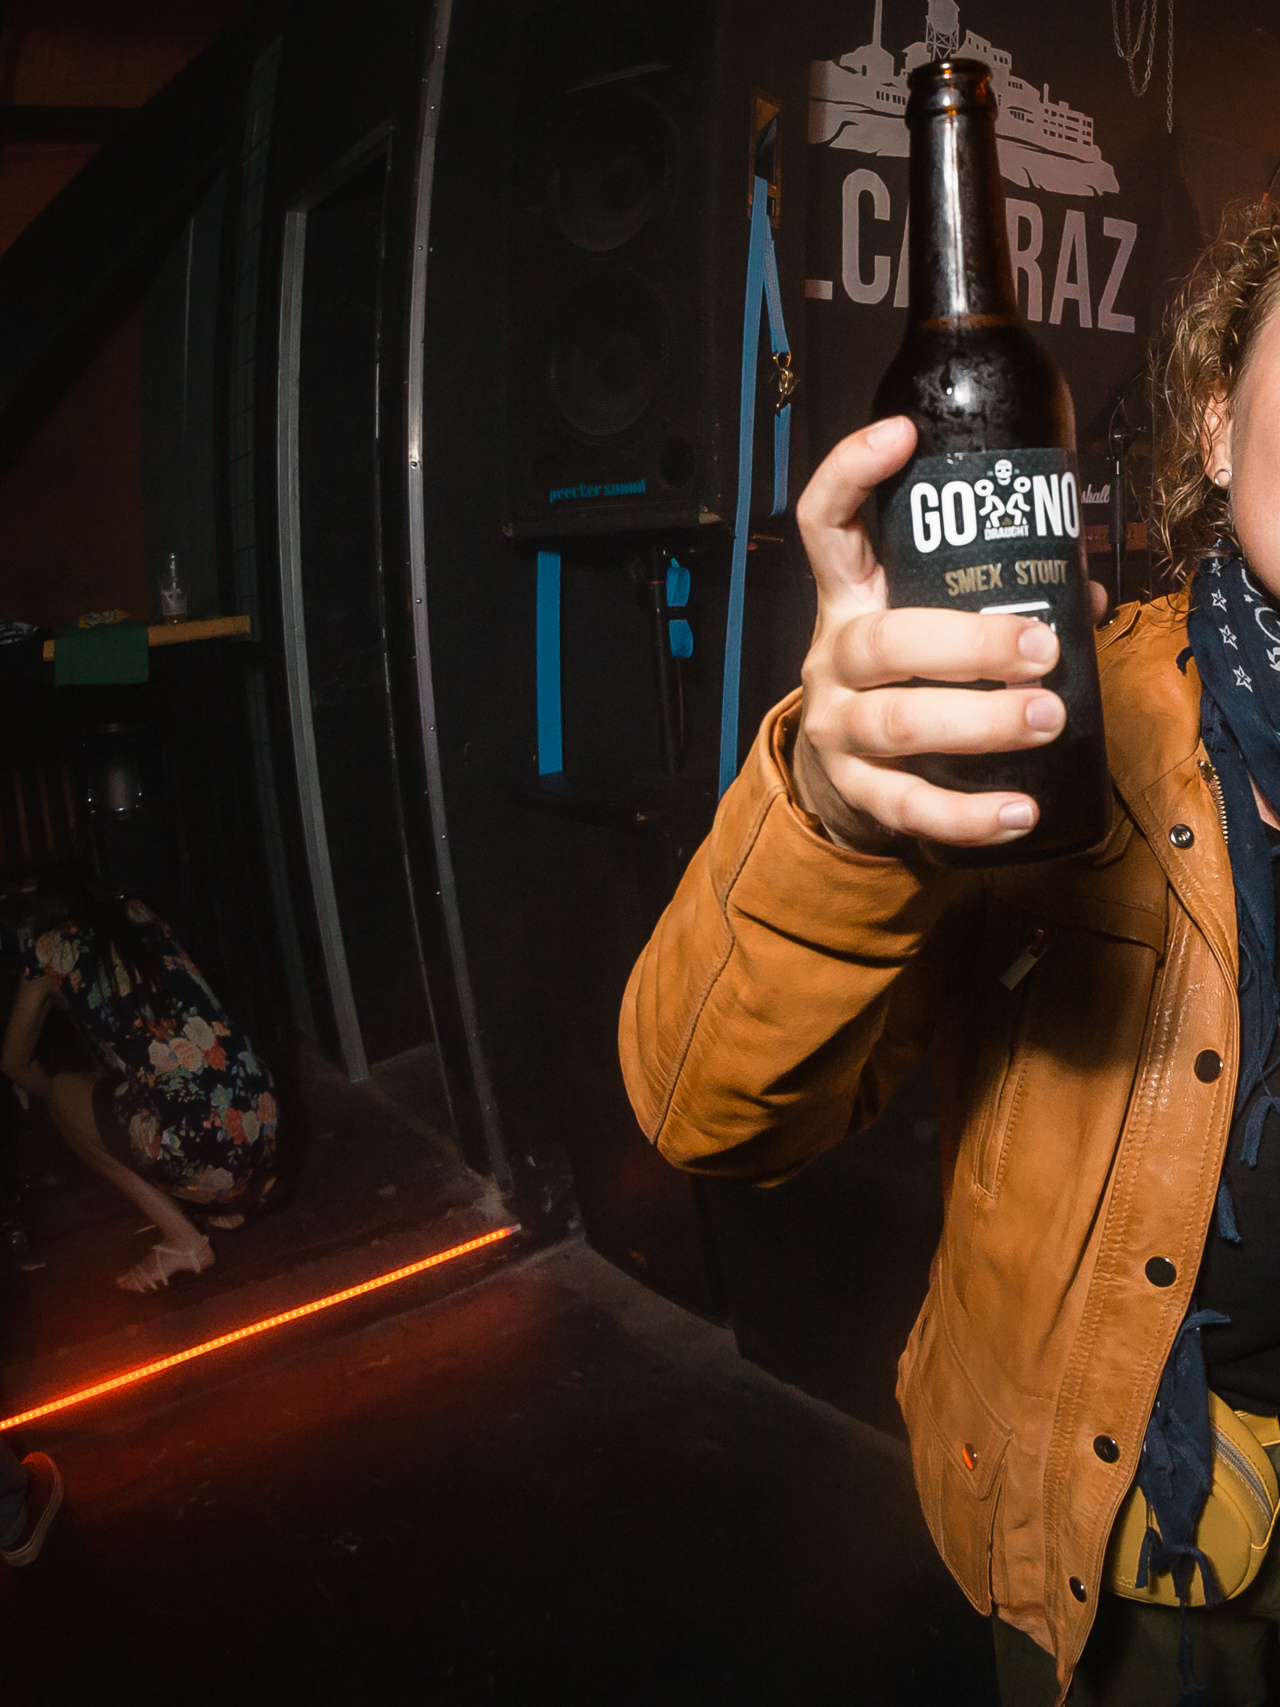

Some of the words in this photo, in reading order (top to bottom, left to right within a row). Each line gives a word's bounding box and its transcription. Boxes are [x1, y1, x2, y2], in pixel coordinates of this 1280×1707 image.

[805, 168, 1137, 333] CRAZ
[603, 479, 646, 496] sound
[910, 481, 977, 553] GO
[1032, 472, 1080, 538] NO
[945, 563, 1003, 596] SMEX
[1015, 560, 1068, 585] STOUT
